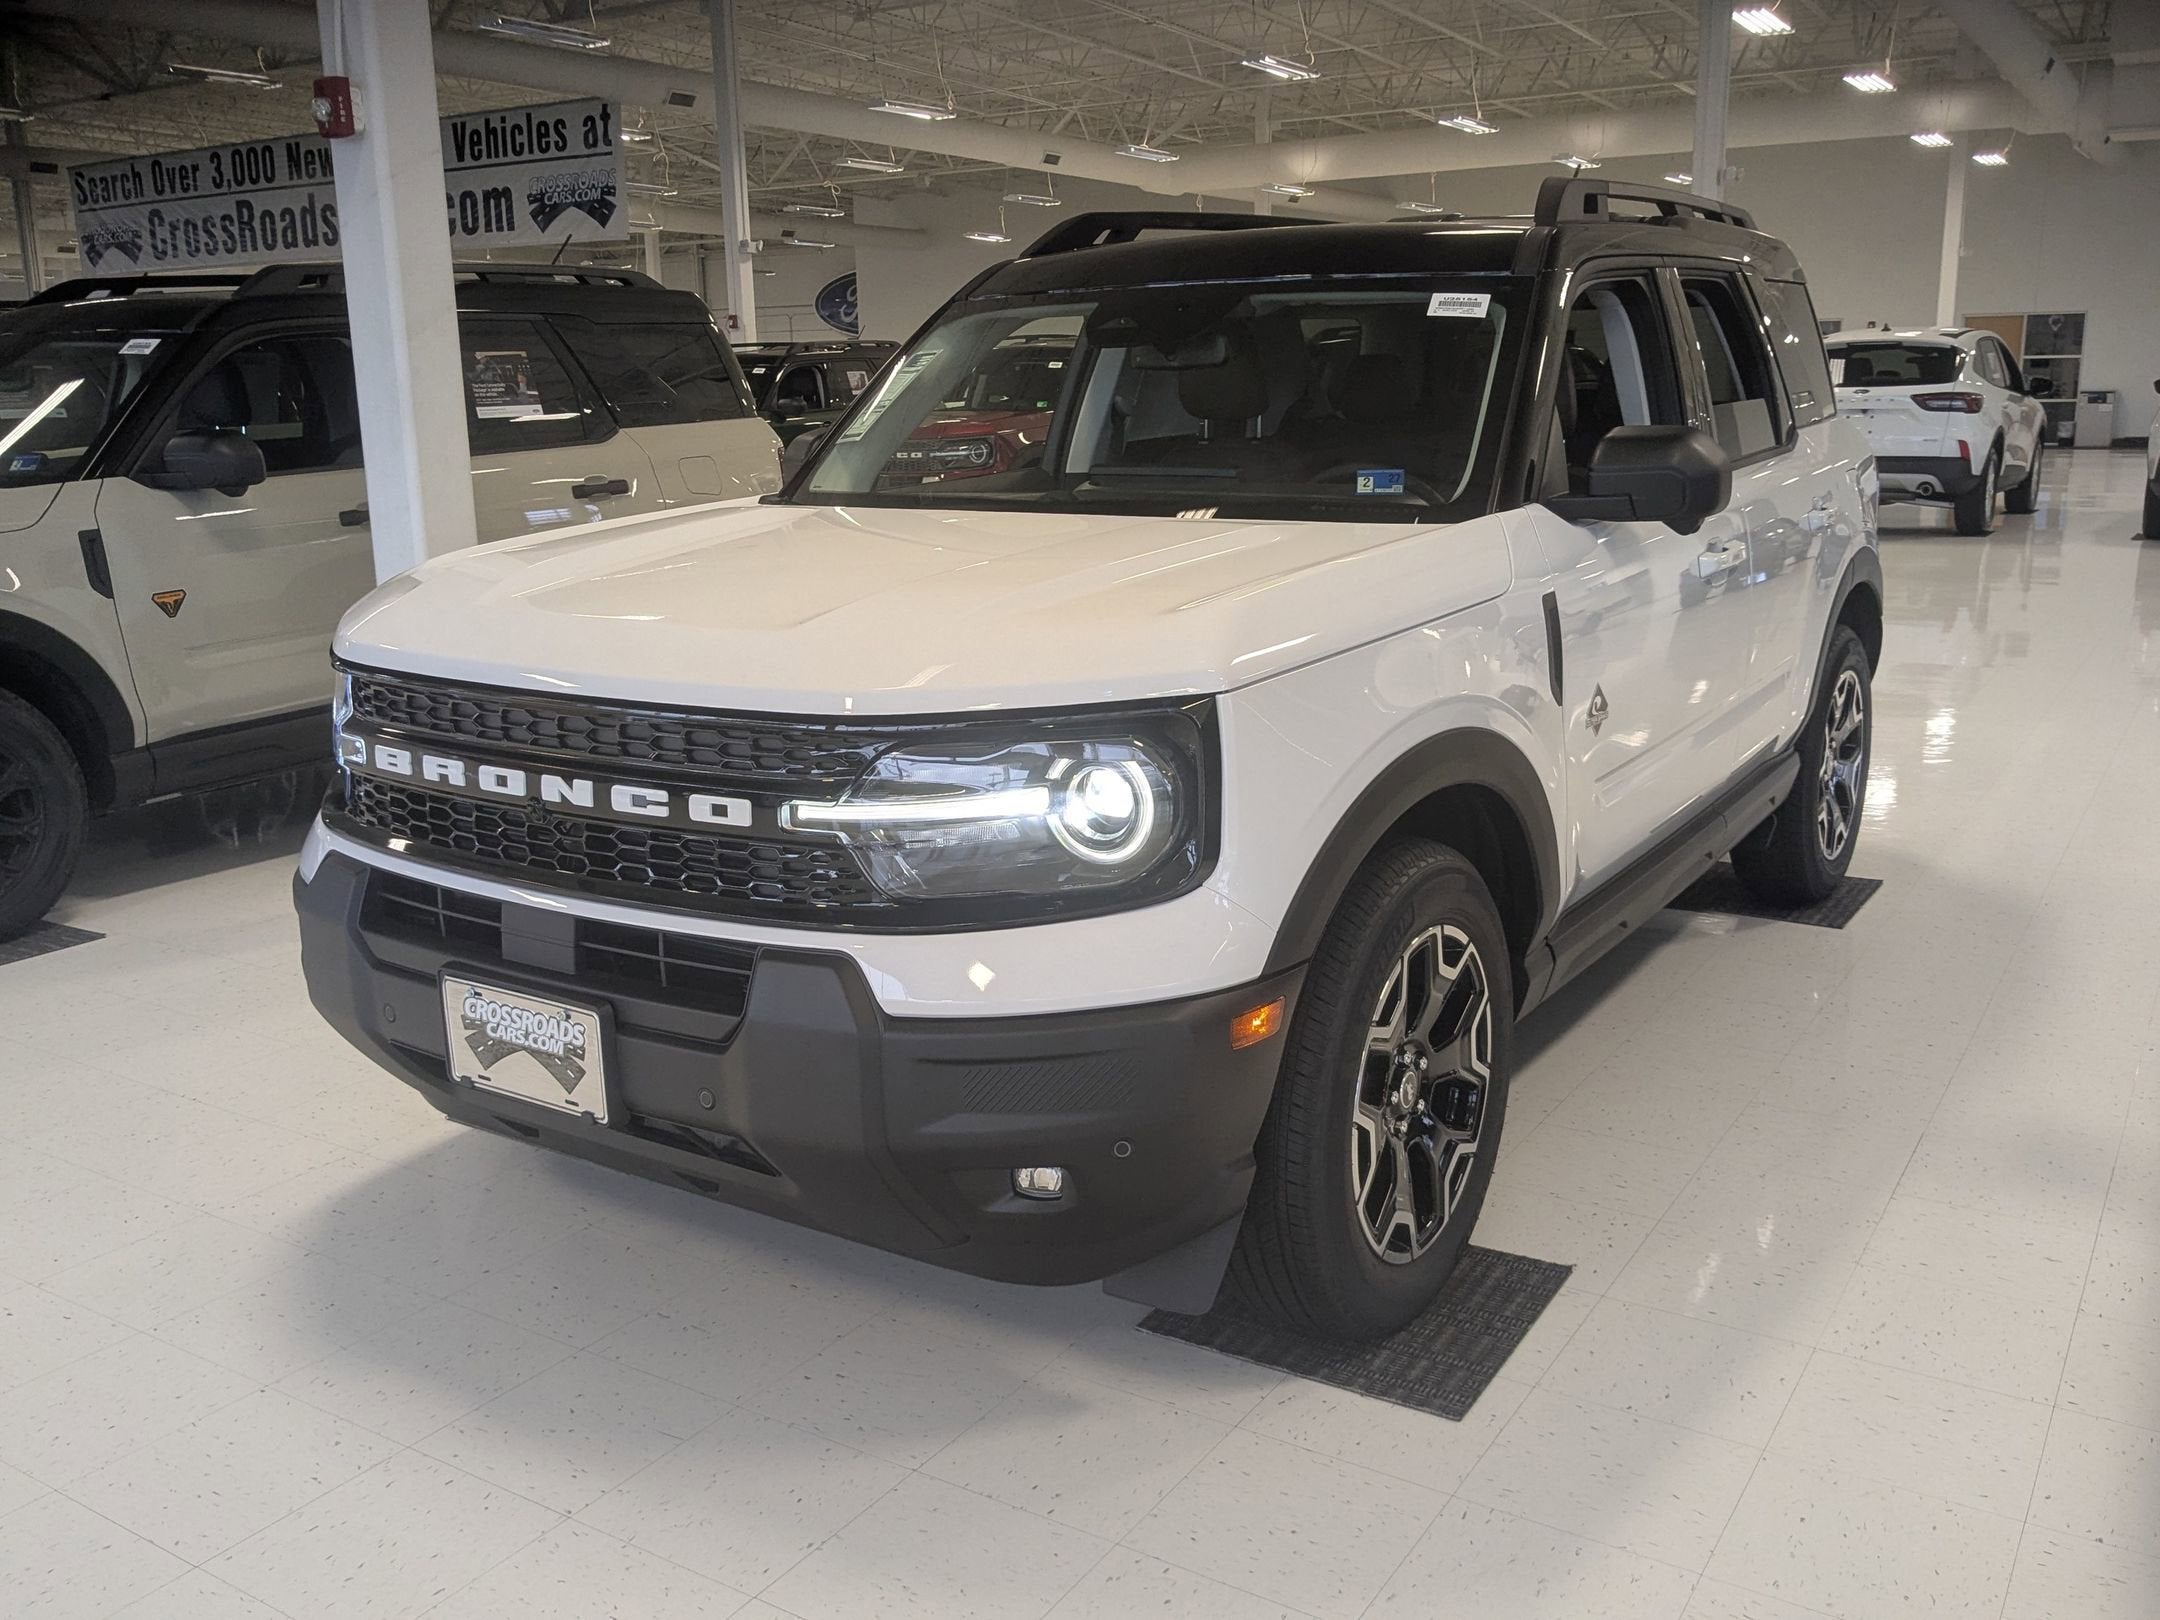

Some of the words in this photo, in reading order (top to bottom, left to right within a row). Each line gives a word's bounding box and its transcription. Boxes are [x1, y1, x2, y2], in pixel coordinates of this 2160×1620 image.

[74, 163, 145, 206] Search
[151, 159, 200, 197] Over
[209, 145, 276, 192] 3,000
[286, 142, 334, 181] New
[452, 111, 567, 163] Vehicles
[582, 103, 612, 150] at
[529, 168, 617, 195] CROSSROADS
[543, 187, 602, 205] CARS.COM
[1362, 477, 1371, 488] 2
[374, 744, 753, 828] BRONCO
[463, 996, 587, 1048] CROSSROADS
[486, 1021, 565, 1056] CARS.COM
